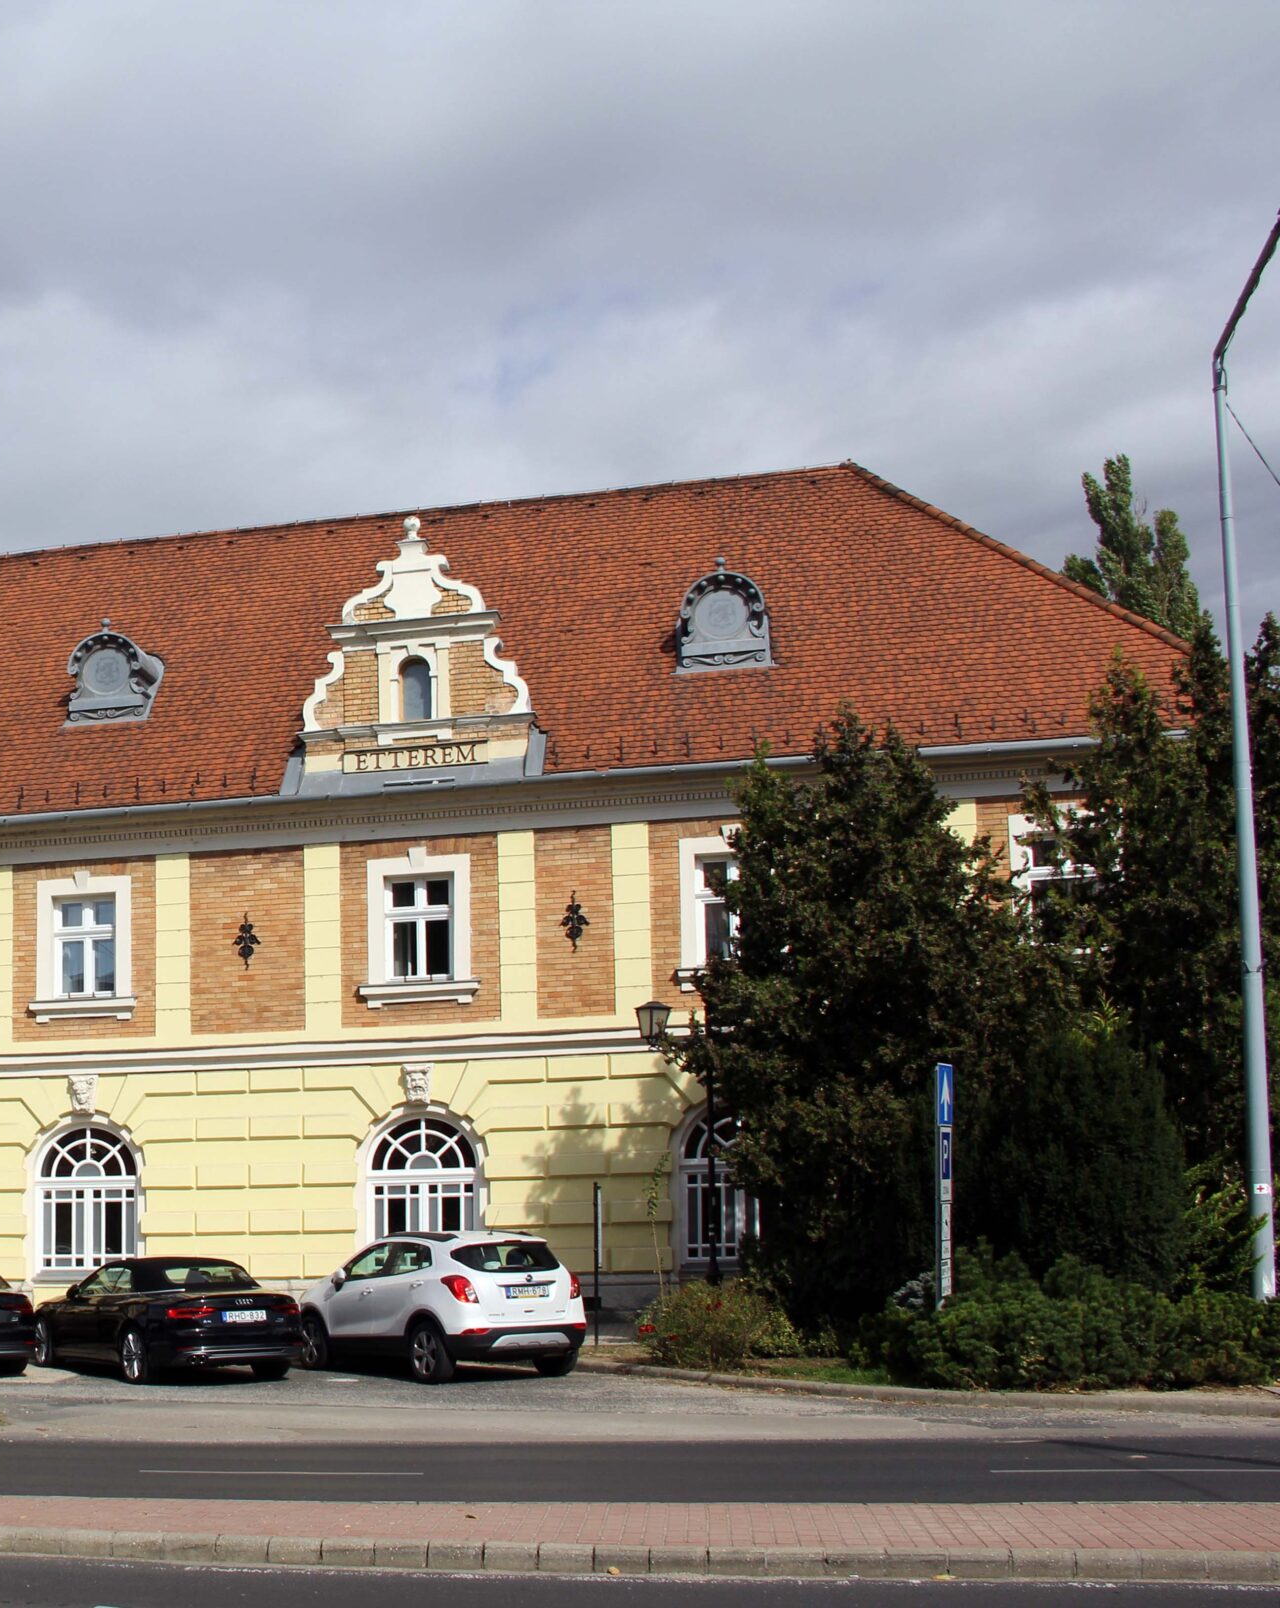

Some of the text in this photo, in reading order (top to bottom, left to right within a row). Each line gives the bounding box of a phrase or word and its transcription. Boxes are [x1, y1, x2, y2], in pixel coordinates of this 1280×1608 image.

[354, 744, 477, 770] ETTEREM
[943, 1139, 949, 1173] P
[228, 1311, 265, 1320] RHD-832
